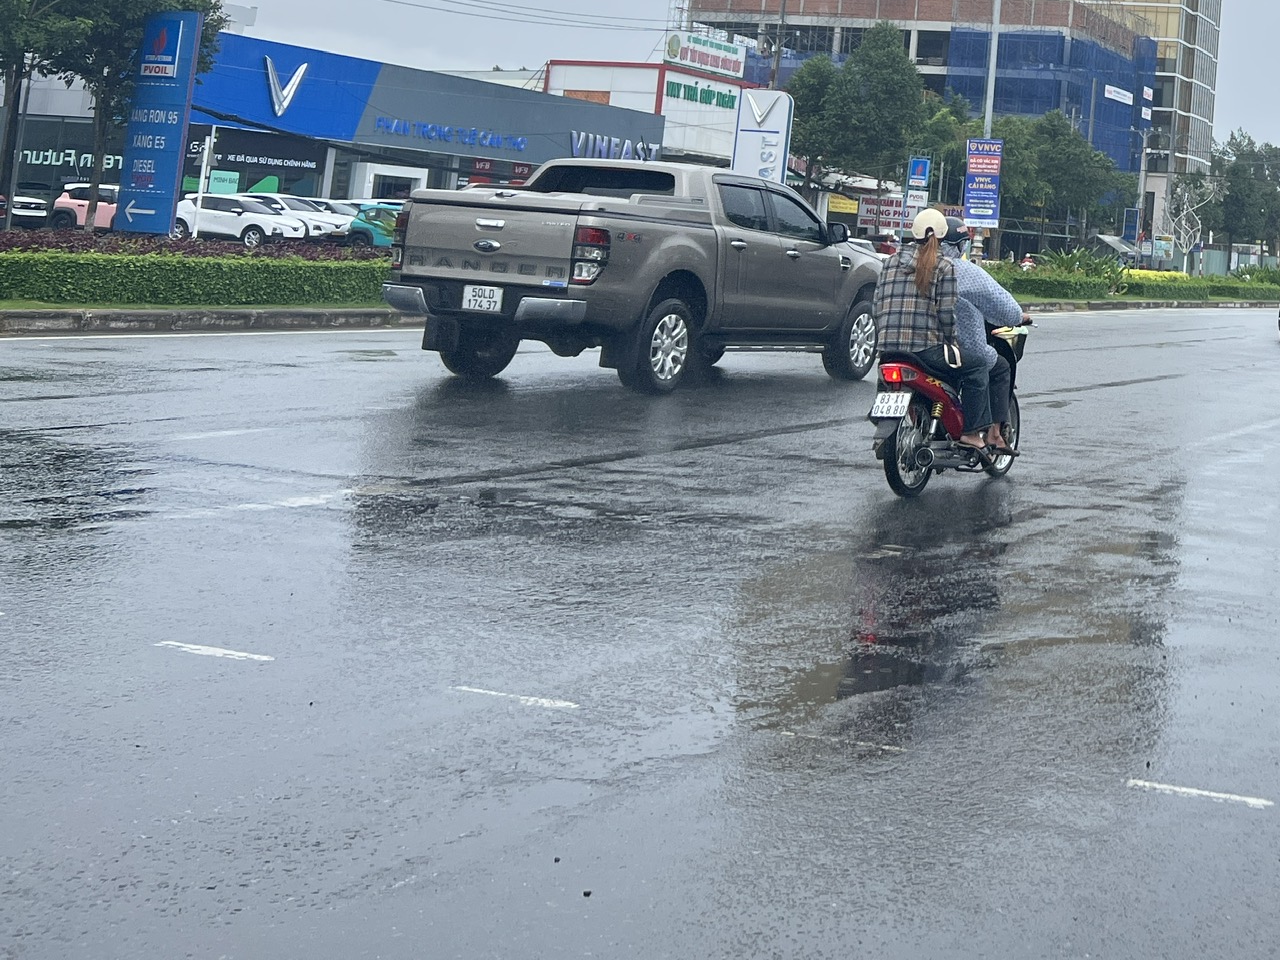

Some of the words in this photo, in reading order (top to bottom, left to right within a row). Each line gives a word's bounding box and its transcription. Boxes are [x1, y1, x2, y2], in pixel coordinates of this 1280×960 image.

[143, 65, 169, 75] PVOIL
[666, 81, 682, 98] VAY
[683, 81, 699, 102] TRẢ
[700, 84, 716, 105] GÓP
[716, 89, 737, 109] NGÀY
[148, 109, 167, 124] RON
[168, 112, 178, 125] 95
[375, 116, 410, 136] PHAN
[413, 121, 453, 144] TRỌNG
[154, 136, 166, 150] E5
[569, 130, 660, 161] VINFAST
[977, 143, 1002, 152] VNVC
[227, 154, 236, 162] XE
[236, 154, 245, 162] ĐÃ
[133, 159, 156, 174] DIESEL
[475, 161, 490, 170] VF8
[515, 166, 529, 174] VF9
[471, 287, 495, 299] 50LD
[467, 299, 497, 311] 174.37
